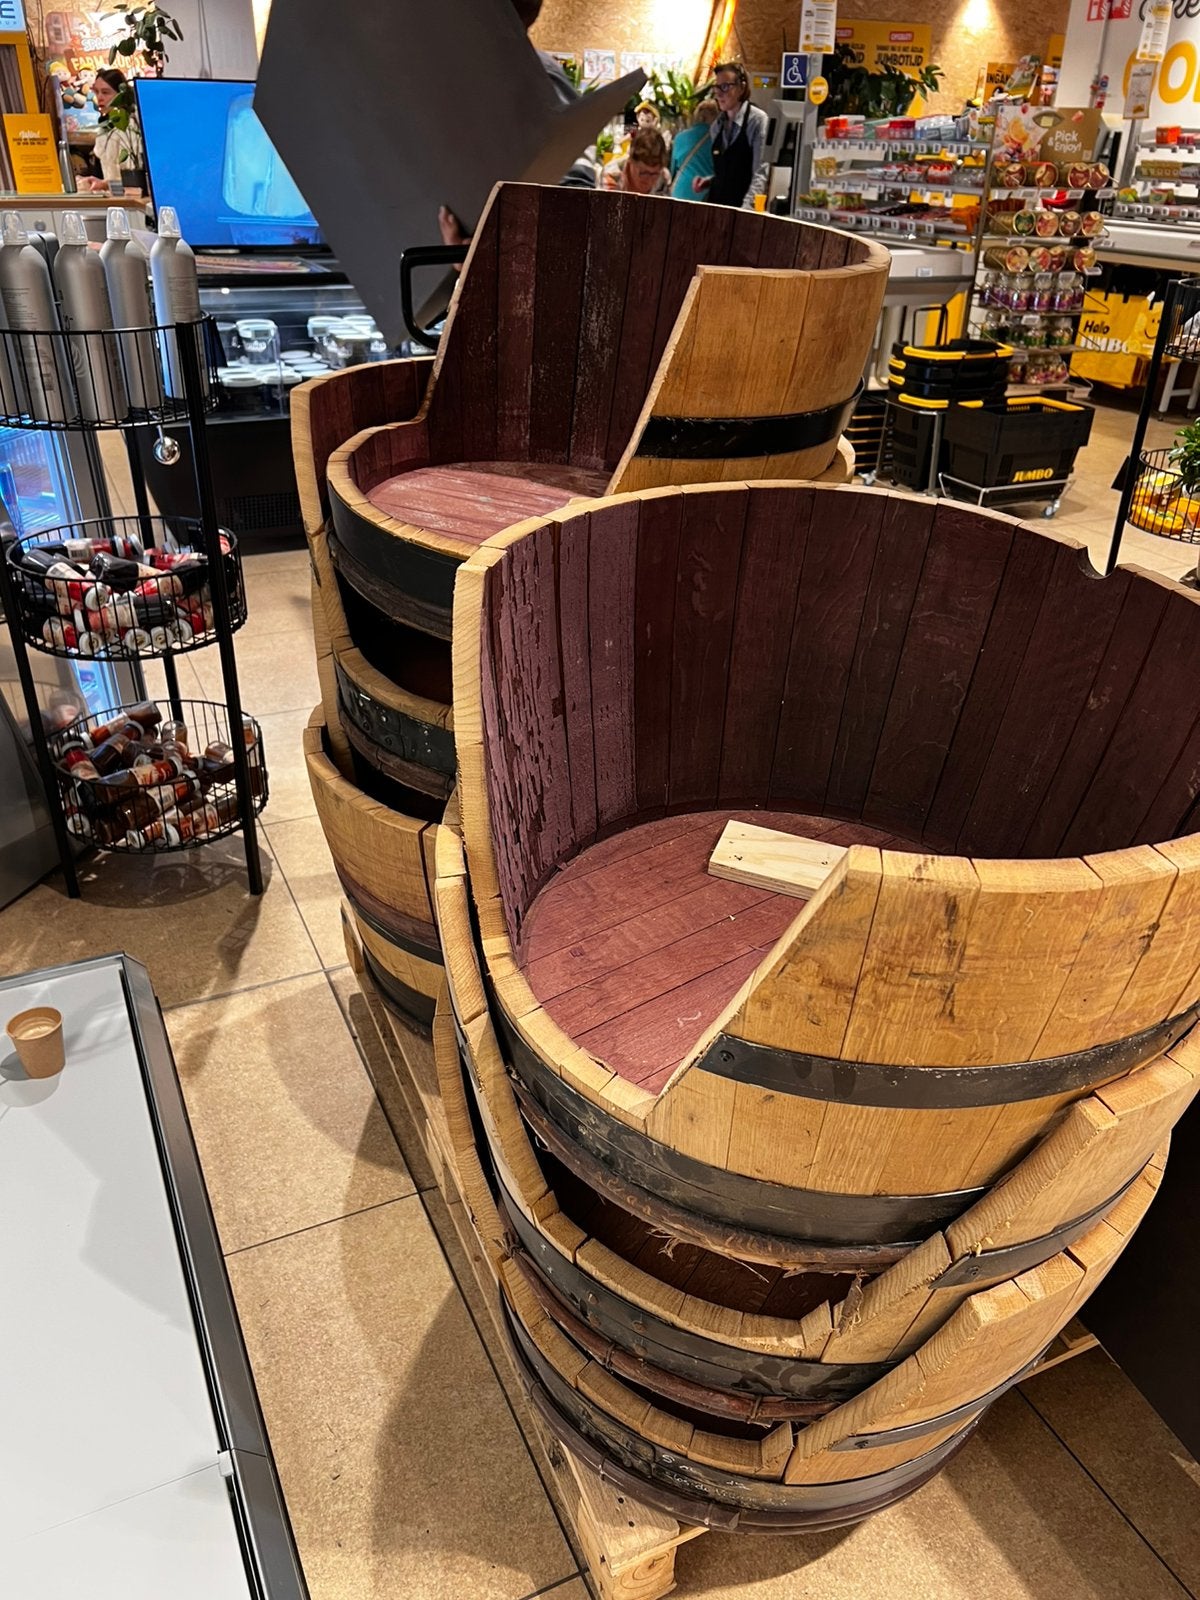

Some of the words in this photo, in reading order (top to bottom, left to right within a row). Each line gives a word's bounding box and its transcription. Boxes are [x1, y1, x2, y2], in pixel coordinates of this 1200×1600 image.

[1055, 130, 1078, 141] Pick
[1054, 141, 1082, 153] Enjoy!
[1012, 467, 1054, 483] JUMBO
